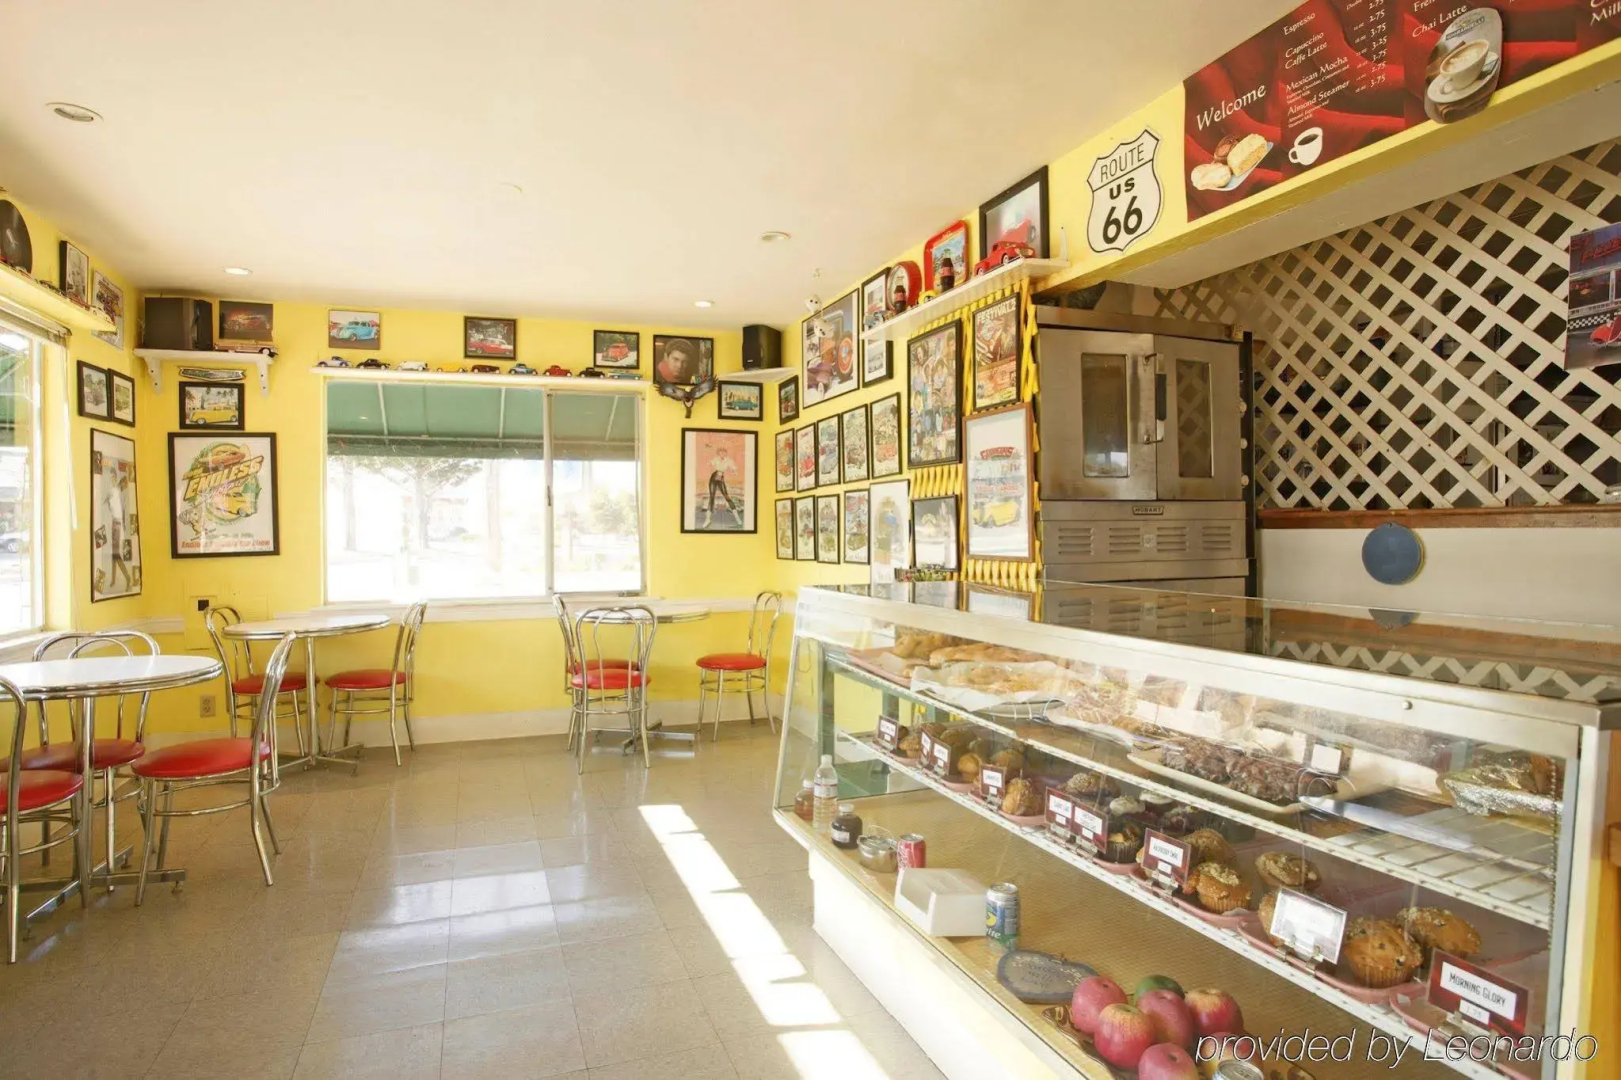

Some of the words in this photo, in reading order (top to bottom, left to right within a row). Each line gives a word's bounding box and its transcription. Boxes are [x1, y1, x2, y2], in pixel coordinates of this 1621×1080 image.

[1283, 12, 1316, 36] Espresso
[1371, 22, 1386, 37] 3.75
[1412, 18, 1437, 38] Chai
[1439, 5, 1467, 24] Latte
[1307, 41, 1328, 57] Latte
[1285, 72, 1318, 92] Mexican
[1319, 56, 1349, 76] Mocha
[1196, 84, 1267, 131] Welcome
[1288, 94, 1317, 116] Almond
[1318, 80, 1350, 101] Steamer
[1100, 142, 1144, 183] ROUTE
[1109, 177, 1135, 200] US
[1102, 195, 1143, 245] 66
[1449, 972, 1481, 996] MORNING
[1482, 987, 1507, 1007] GLORY
